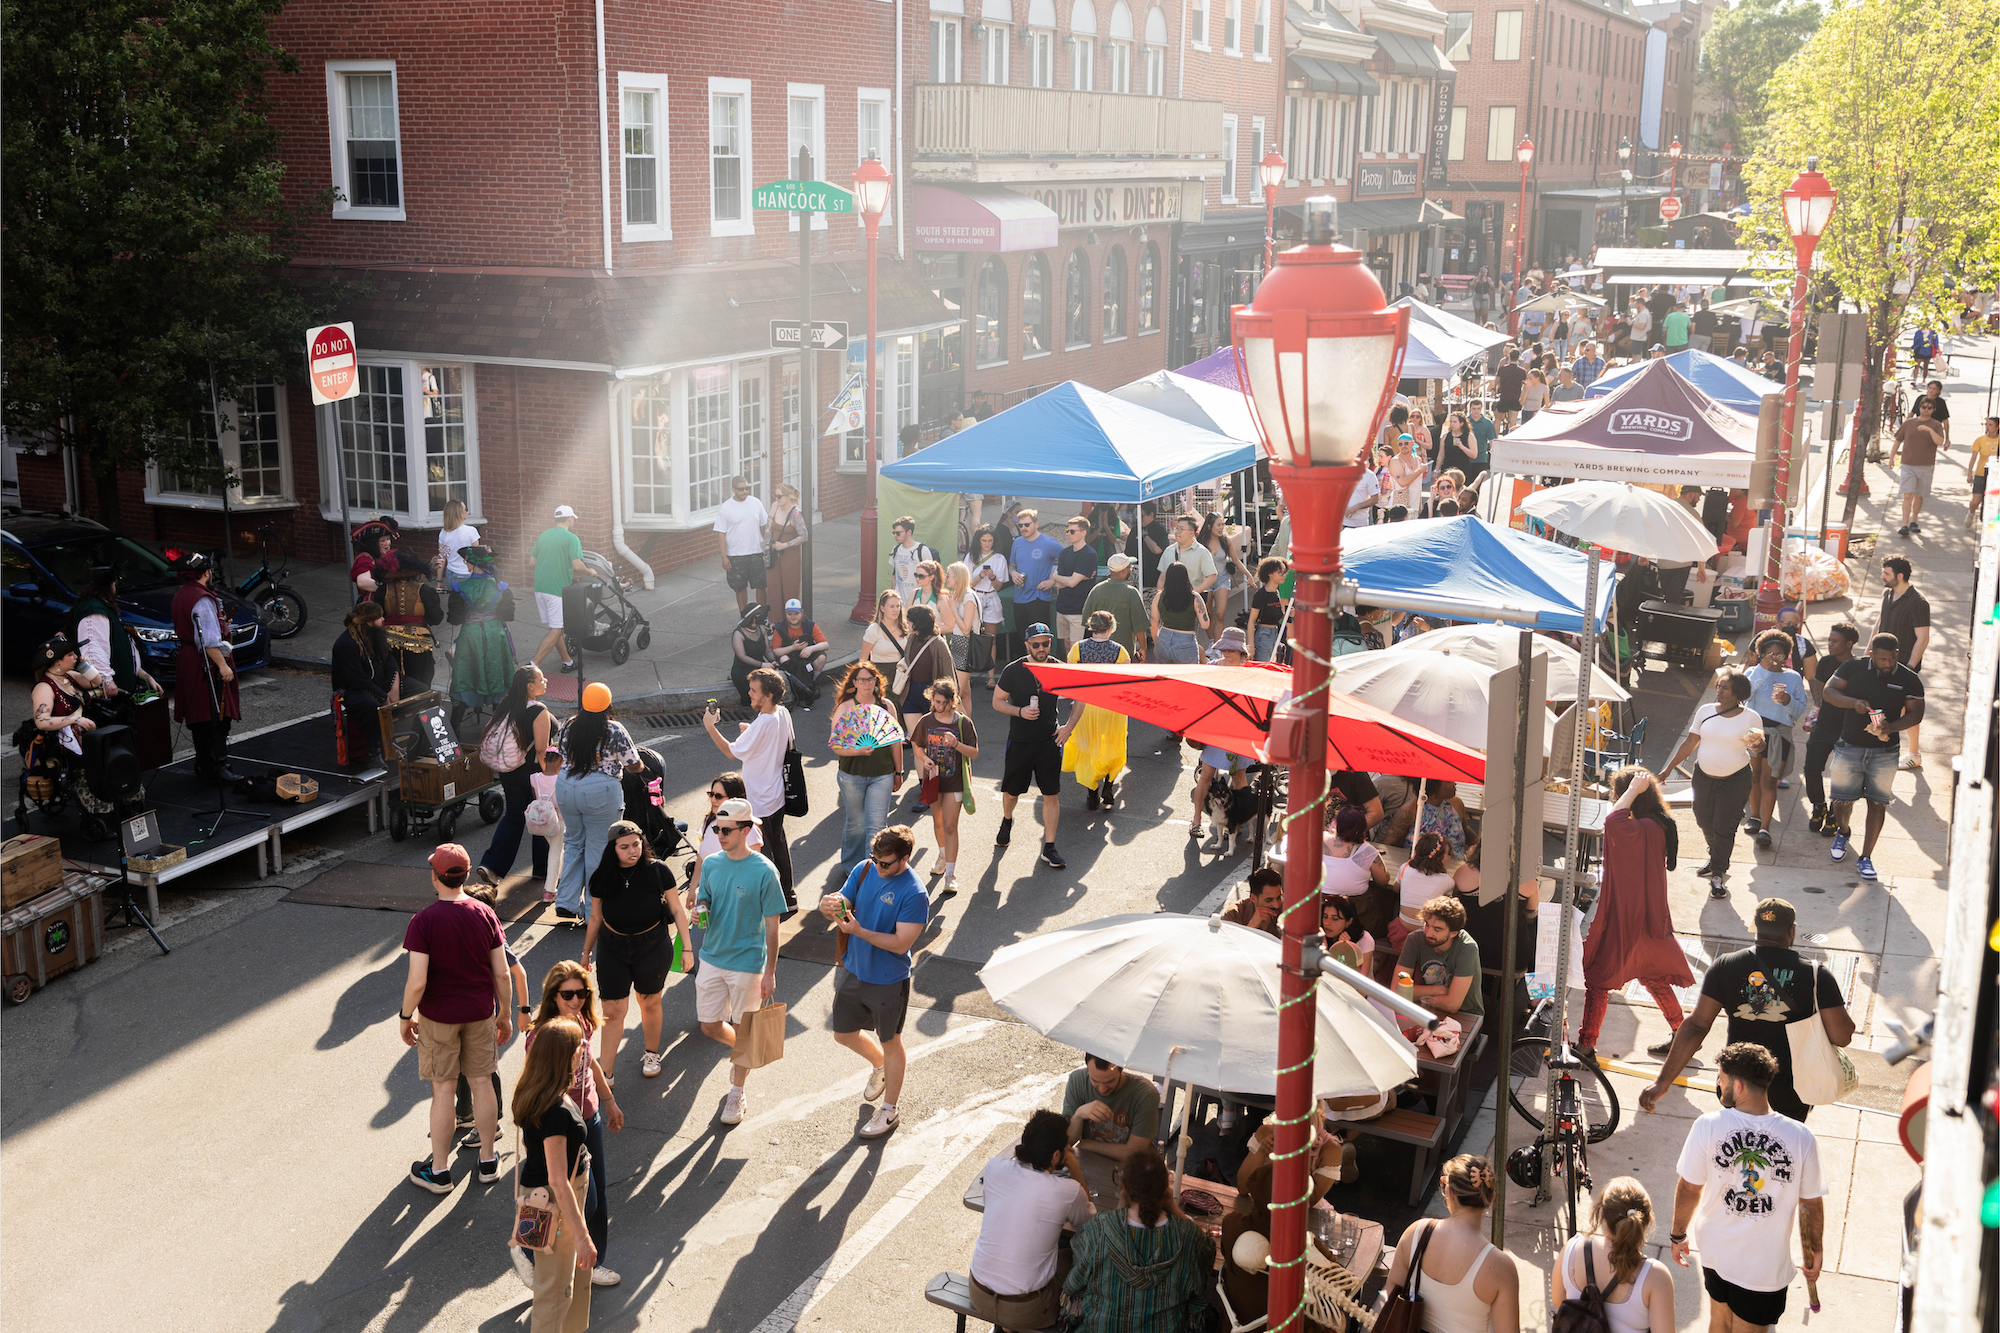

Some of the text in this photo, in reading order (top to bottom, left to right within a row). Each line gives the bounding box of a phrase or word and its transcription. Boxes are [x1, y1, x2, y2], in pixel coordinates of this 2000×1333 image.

[799, 182, 804, 192] S
[758, 191, 844, 211] HANCOCK ST
[1093, 187, 1117, 222] ST.
[1123, 186, 1166, 221] DINER
[1166, 198, 1177, 219] 24
[915, 226, 996, 237] SOUTH STREET DINER
[778, 329, 825, 341] ONE AY
[315, 338, 348, 356] DO NOT
[321, 371, 349, 388] ENTER
[1620, 413, 1682, 432] YARDS
[1649, 427, 1678, 436] COMPANY
[1574, 462, 1700, 477] YARDS BREWING COMPANY
[1715, 1131, 1792, 1181] CONCRETE
[1724, 1188, 1773, 1213] EDEN
